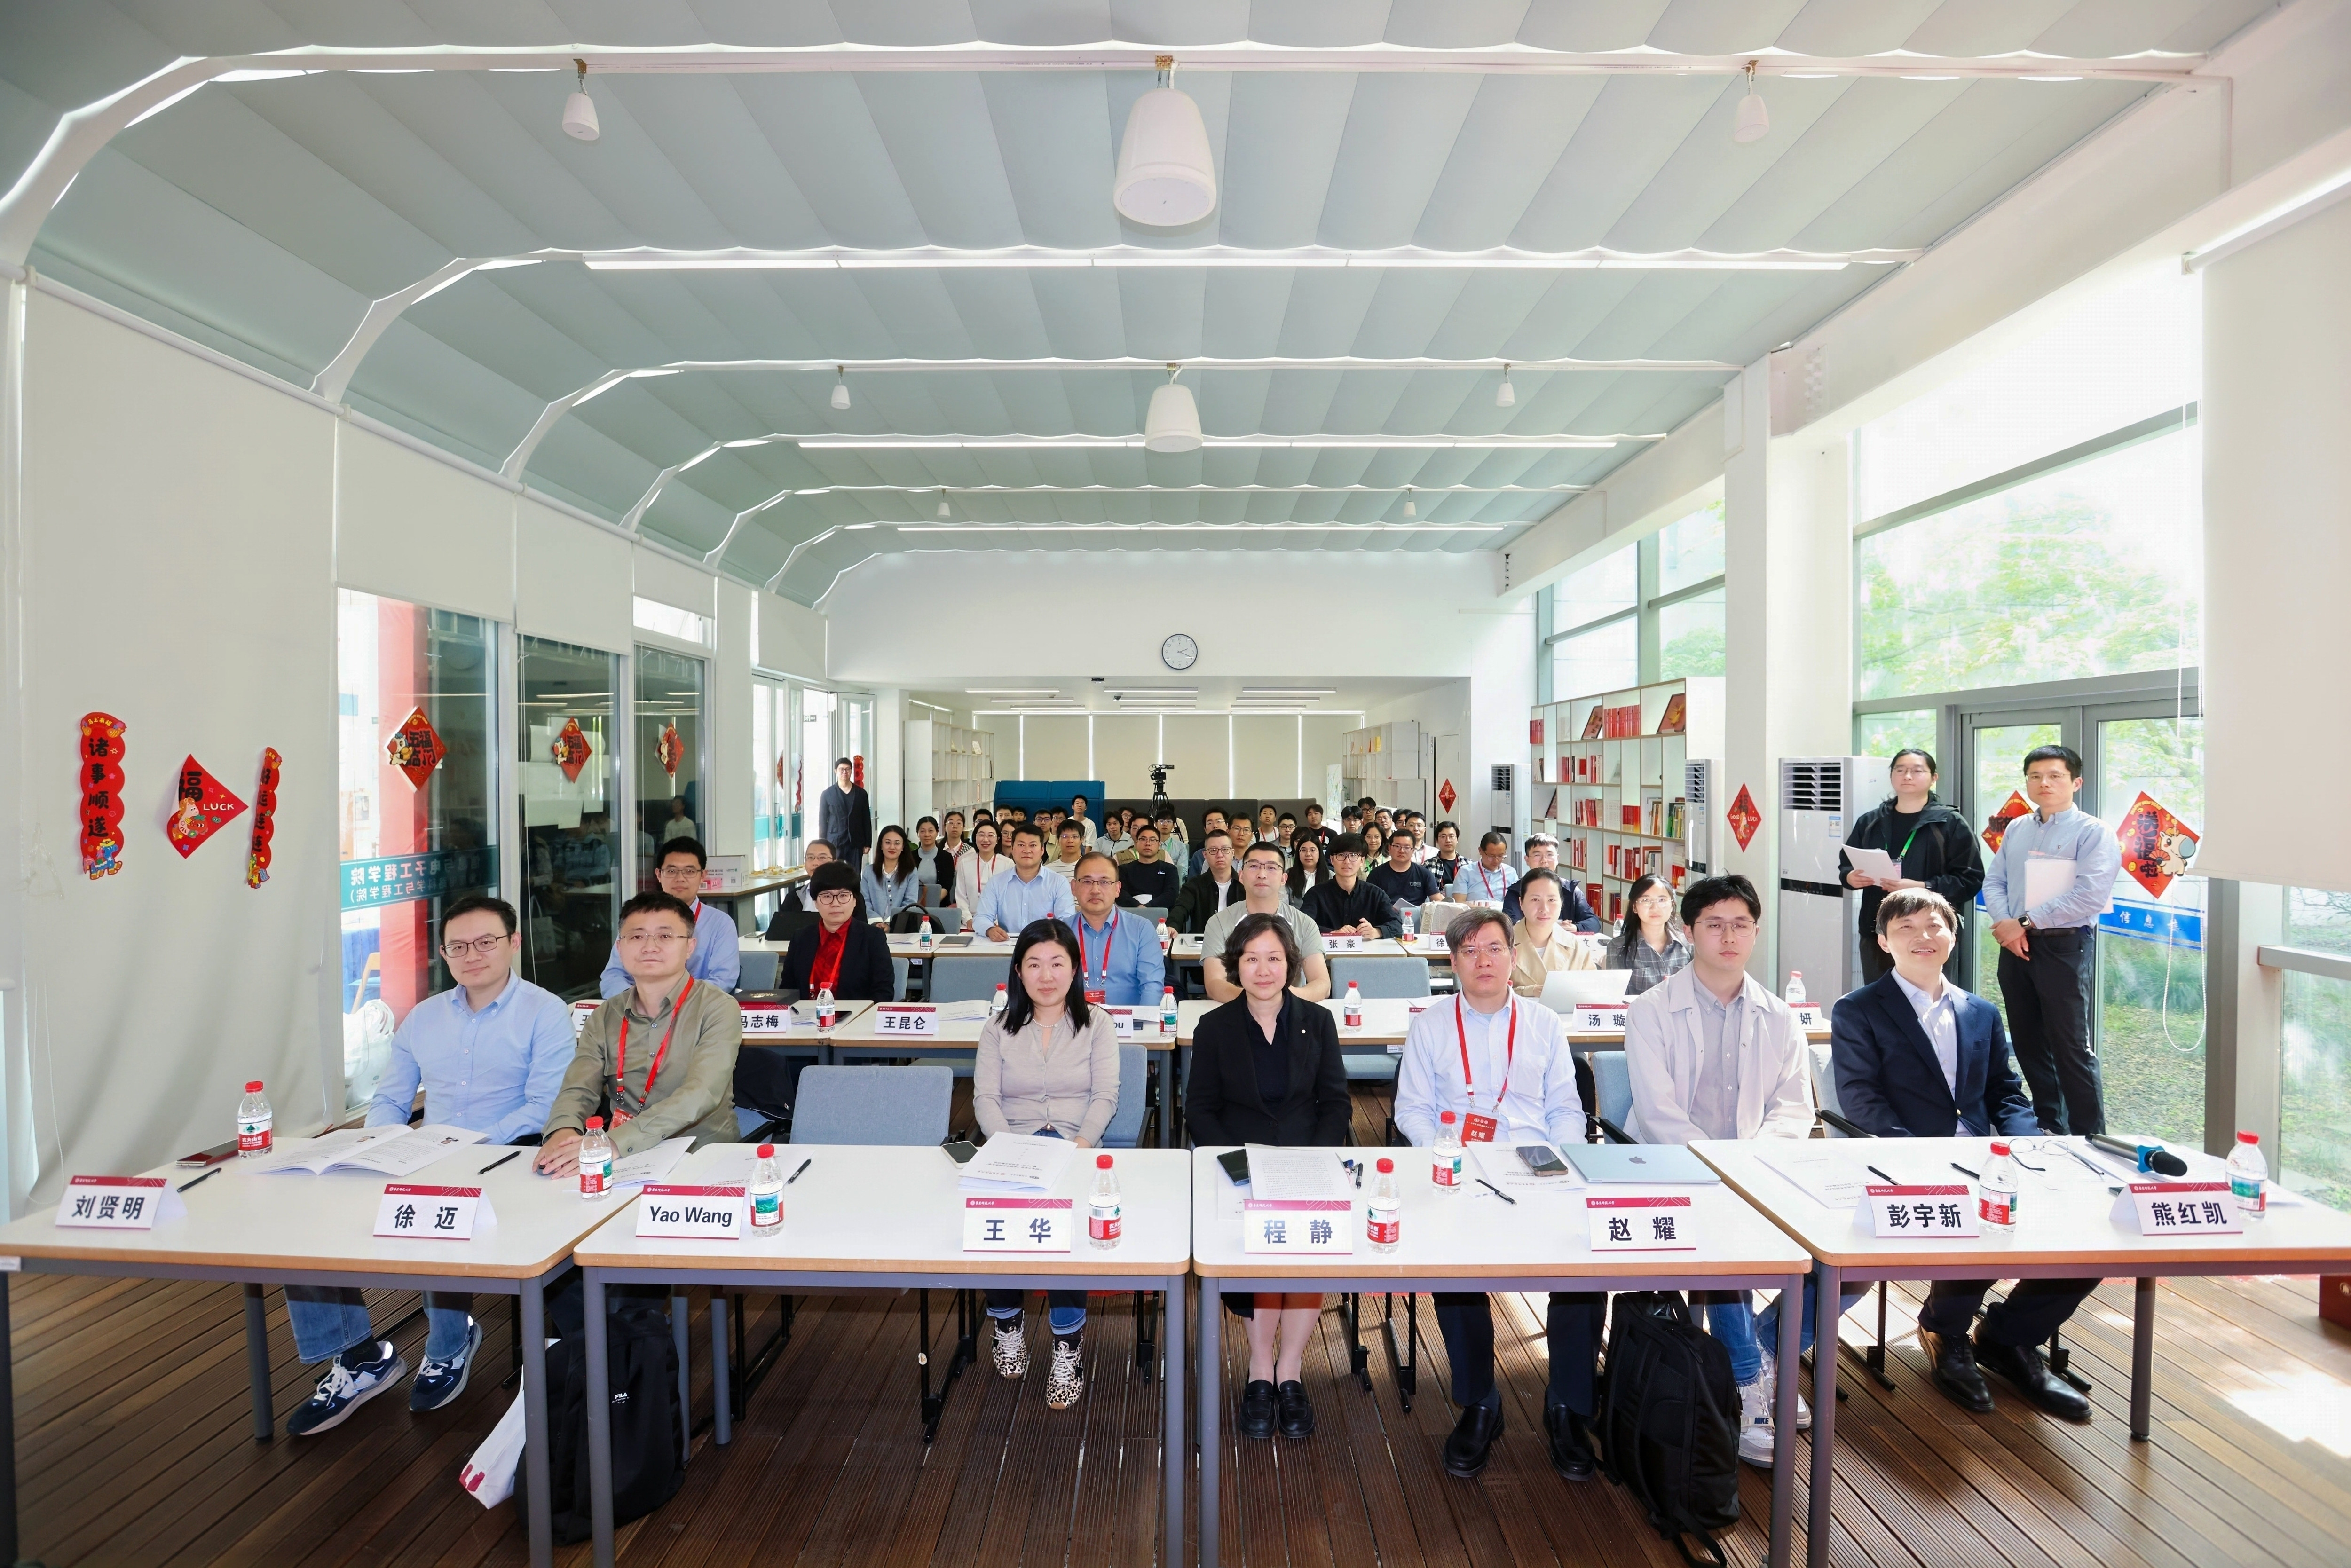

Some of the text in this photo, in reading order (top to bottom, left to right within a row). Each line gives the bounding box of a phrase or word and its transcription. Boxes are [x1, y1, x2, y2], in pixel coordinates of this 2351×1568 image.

[88, 717, 112, 726] 马上有福
[88, 737, 110, 837] 诸事顺遂
[203, 803, 235, 811] LUCK
[883, 1016, 926, 1030] 王昆仑
[71, 1195, 145, 1220] 刘贤明
[394, 1204, 458, 1230] 徐迈
[650, 1206, 732, 1228] Yao Wang
[1887, 1203, 1962, 1229] 彭宇新
[2151, 1201, 2227, 1227] 熊红凯
[983, 1218, 1051, 1243] 王华
[1263, 1219, 1333, 1244] 程静
[1609, 1217, 1676, 1242] 赵耀
